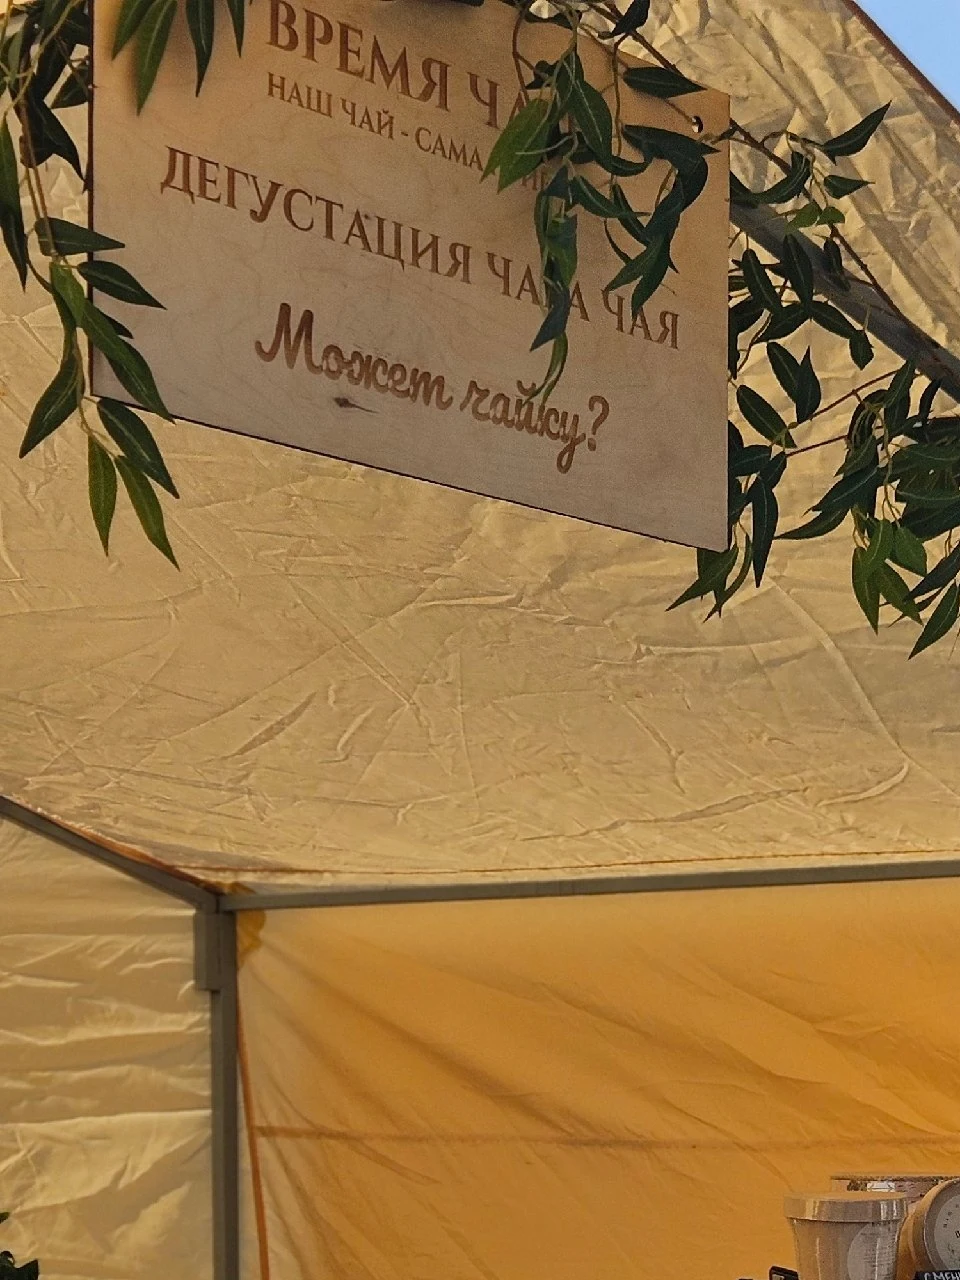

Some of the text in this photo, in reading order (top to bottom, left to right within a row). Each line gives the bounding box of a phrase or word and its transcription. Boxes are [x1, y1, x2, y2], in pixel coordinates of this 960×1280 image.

[266, 0, 451, 113] ВРЕМЯ
[267, 72, 333, 119] НАШ
[340, 97, 396, 141] ЧАЙ
[414, 126, 483, 172] САМА
[160, 146, 680, 350] ДЕГУСТАЦИЯ ЧАА ЧАЯ
[459, 379, 610, 475] чайку?
